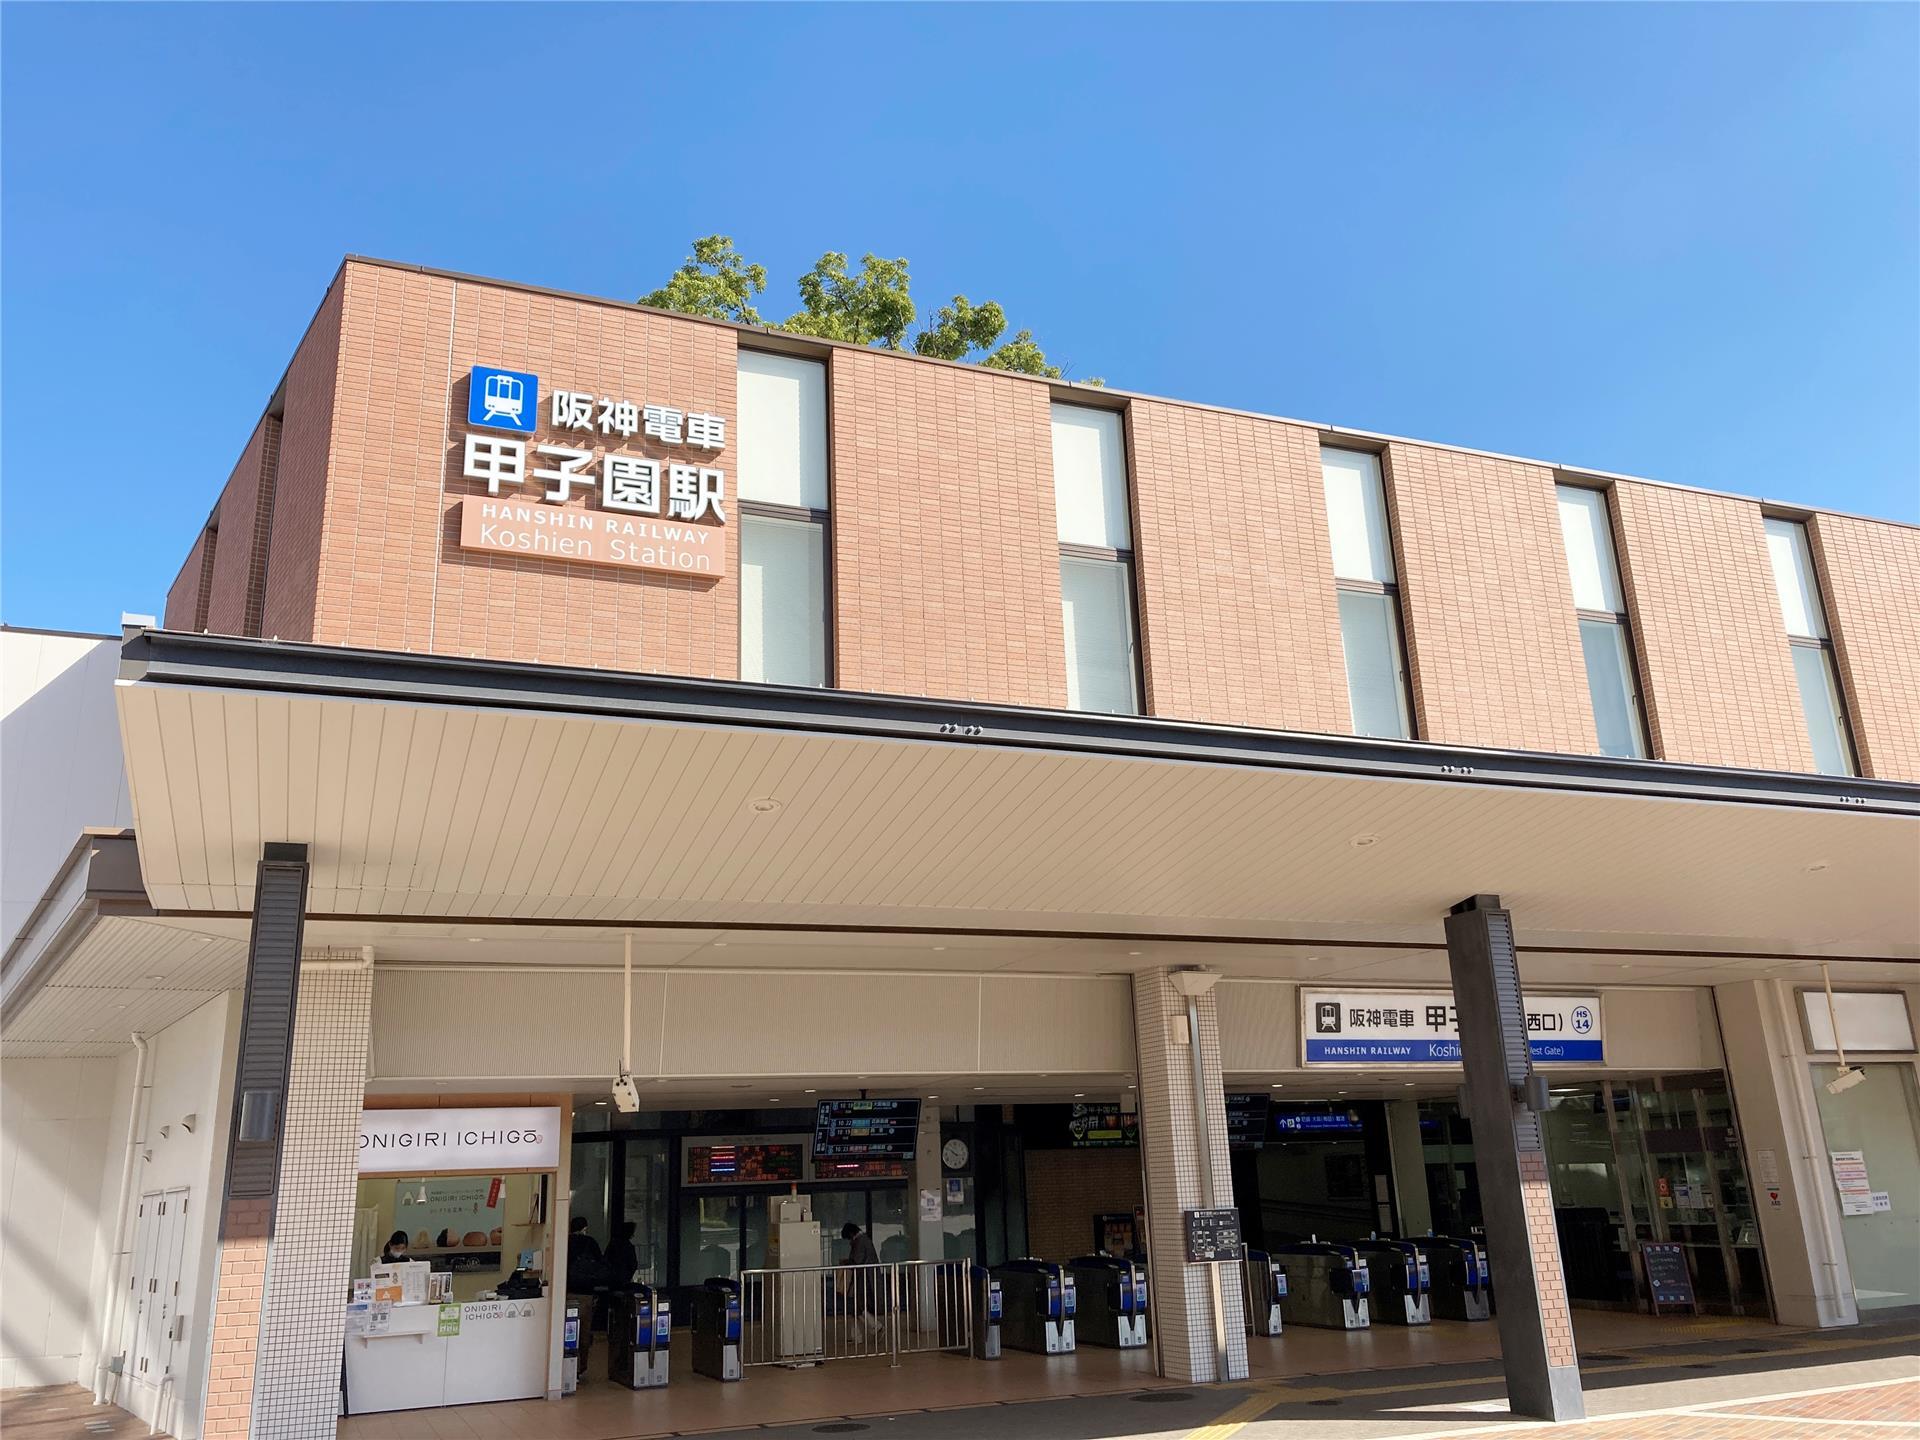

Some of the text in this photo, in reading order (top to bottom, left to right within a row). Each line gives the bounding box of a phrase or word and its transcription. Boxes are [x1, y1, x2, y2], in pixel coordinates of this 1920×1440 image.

[551, 388, 726, 449] 阪神電車
[463, 433, 726, 525] 甲子園駅
[482, 503, 709, 545] HANSHIN RAILWAY
[480, 523, 711, 571] Koshien Station
[1349, 1008, 1415, 1028] 阪神電車
[1576, 1010, 1588, 1018] HS
[1575, 1019, 1590, 1029] 14
[1324, 1046, 1367, 1055] HANSHIN
[1370, 1046, 1411, 1055] RAILWAY
[1544, 1046, 1564, 1056] Gate)
[360, 1132, 447, 1149] ONIGIRI
[464, 1303, 502, 1313] ONIGIRI
